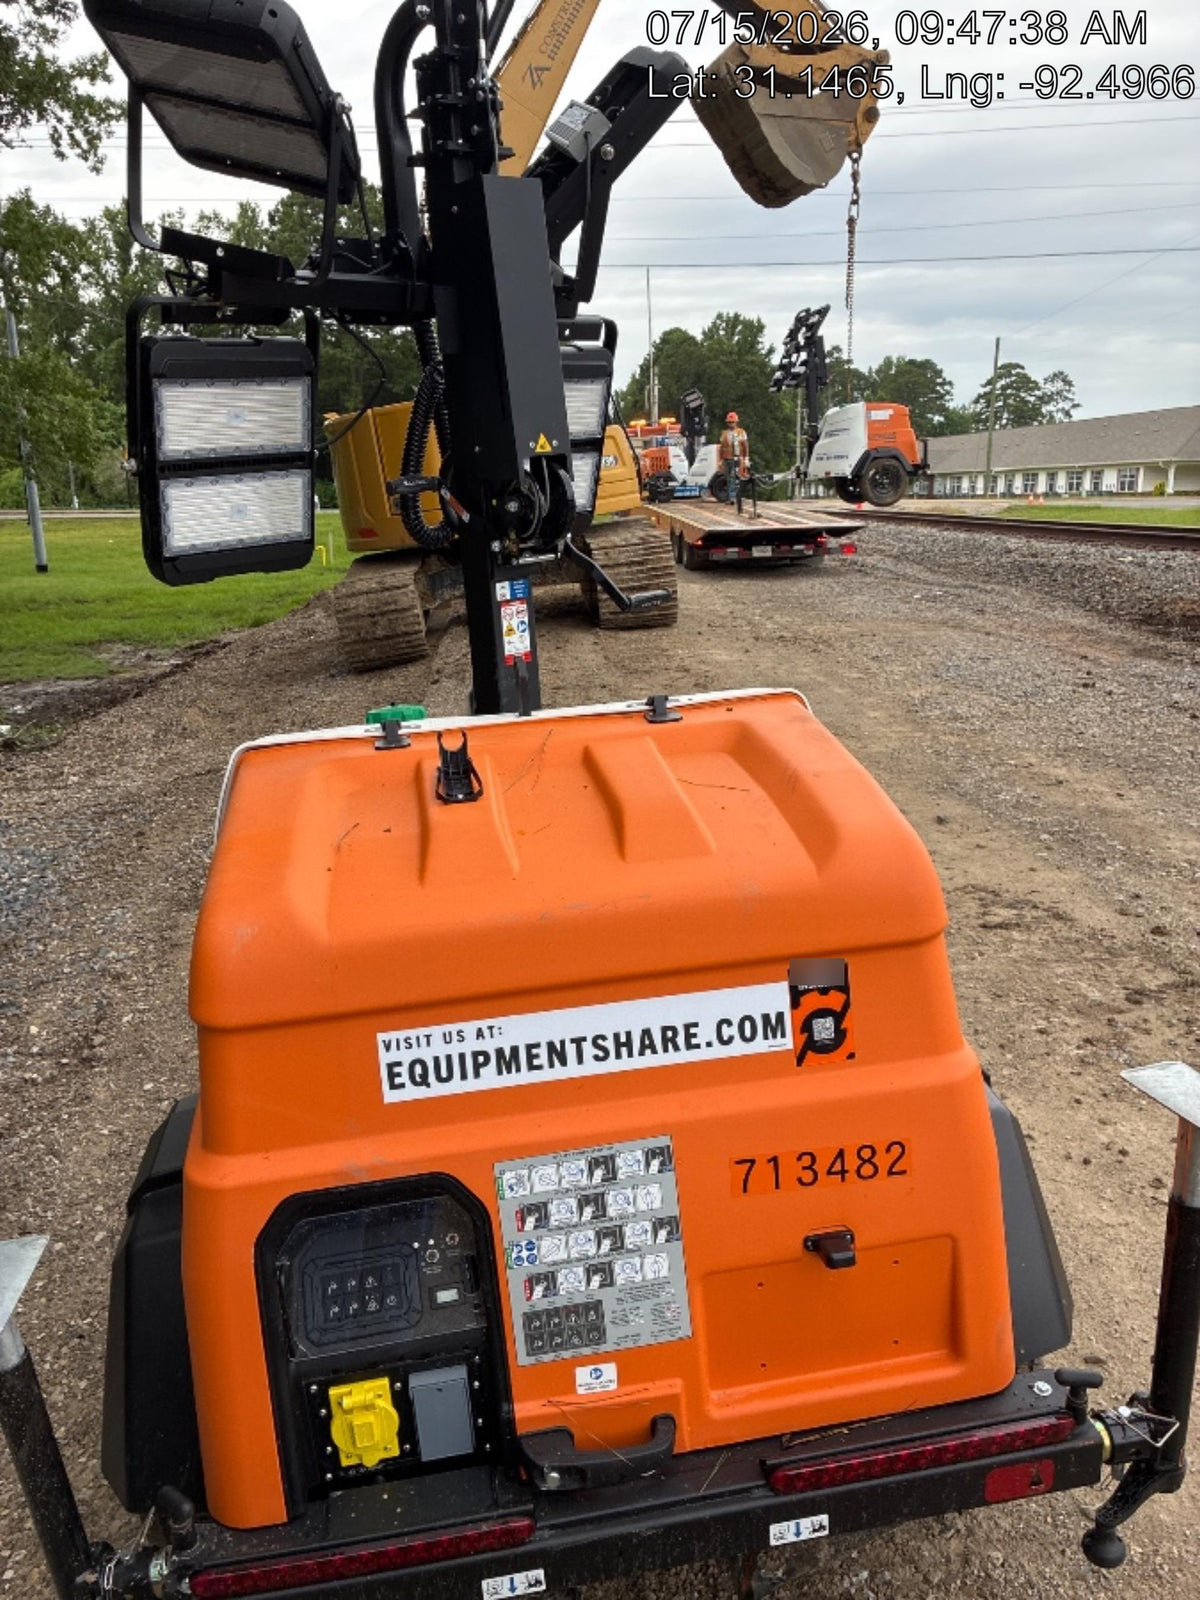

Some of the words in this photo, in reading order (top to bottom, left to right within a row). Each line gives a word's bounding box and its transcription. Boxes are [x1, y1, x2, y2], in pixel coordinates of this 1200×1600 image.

[382, 1034, 432, 1052] VISIT
[443, 1029, 465, 1044] US
[476, 1025, 502, 1040] AT:
[386, 1011, 786, 1090] EQUIPMENTSHARE.COM
[734, 1141, 907, 1193] 713482
